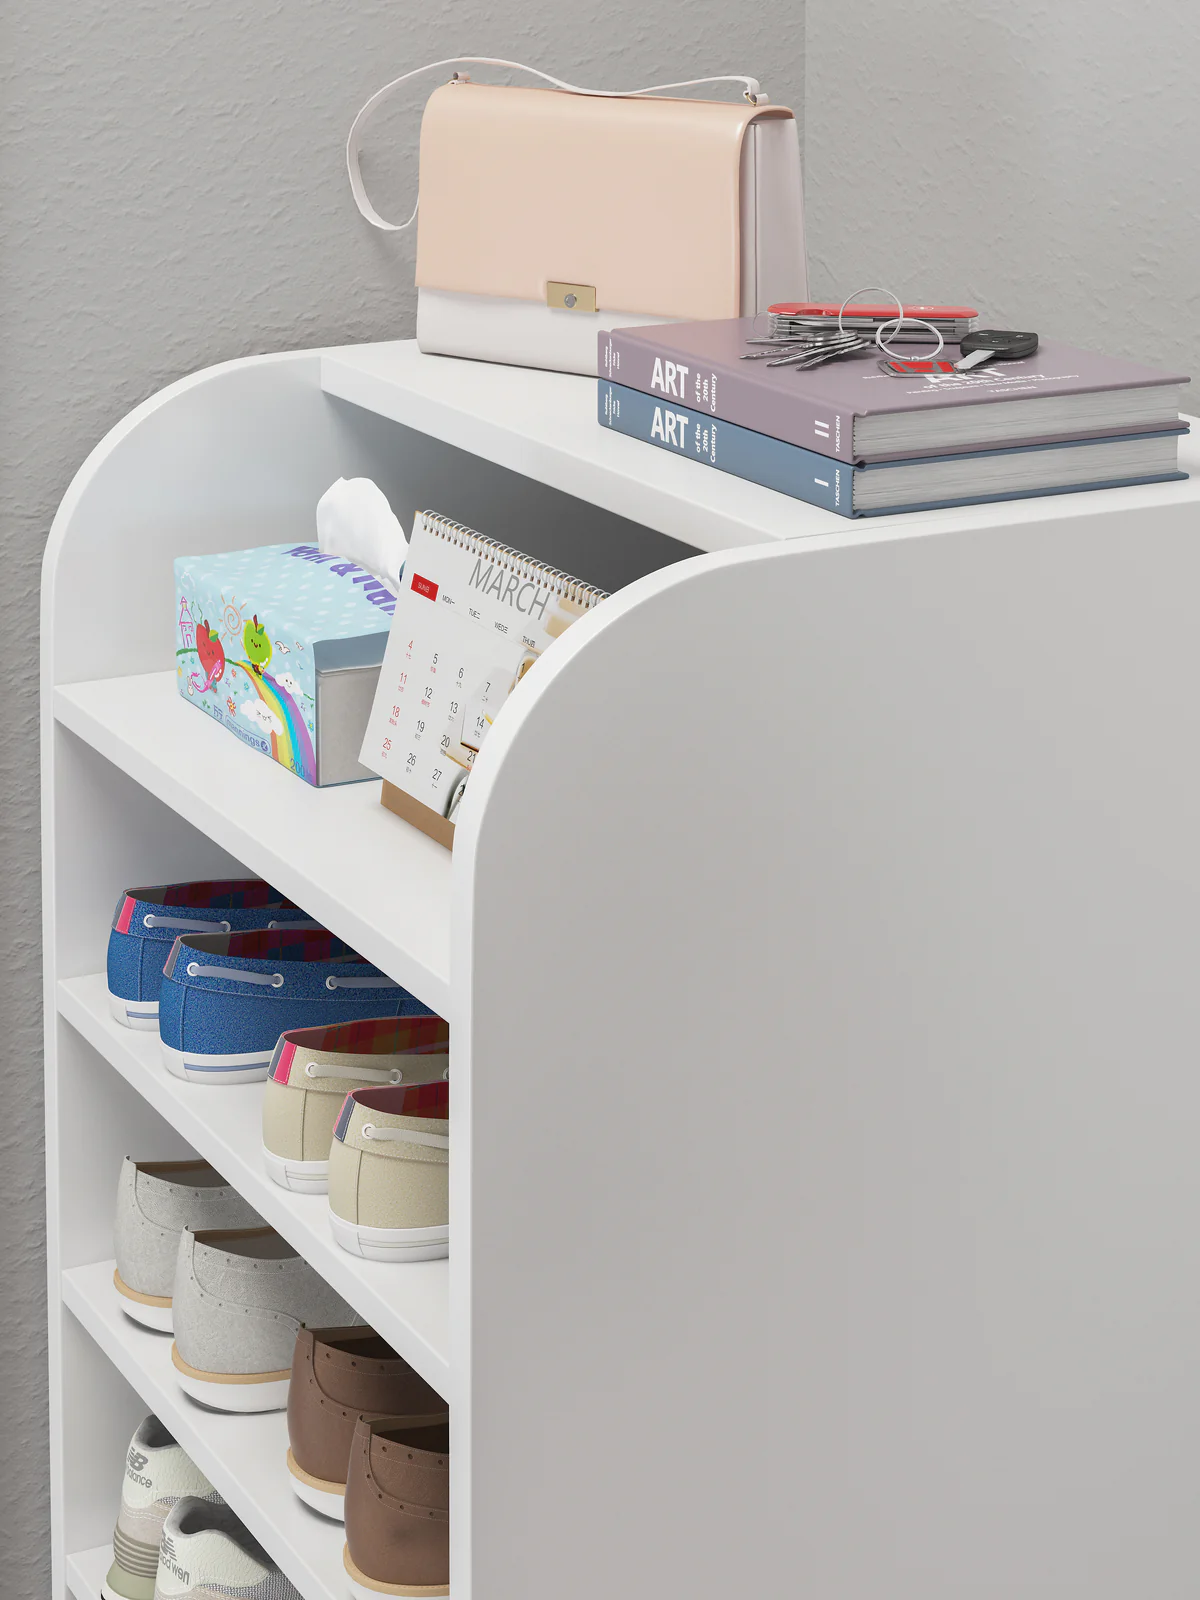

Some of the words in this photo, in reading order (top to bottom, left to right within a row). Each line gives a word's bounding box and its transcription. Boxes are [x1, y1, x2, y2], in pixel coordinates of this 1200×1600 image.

[650, 357, 688, 399] ART
[695, 390, 701, 403] of
[650, 406, 688, 449] ART
[695, 440, 701, 453] of
[468, 558, 551, 620] MARCH
[408, 640, 413, 650] 4
[432, 653, 438, 664] 5
[458, 667, 464, 679] 6
[485, 682, 491, 692] 7
[521, 662, 526, 673] 1
[400, 672, 408, 684] 11
[425, 686, 433, 700] 12
[450, 701, 458, 714] 13
[476, 716, 485, 729] 14
[392, 705, 400, 718] 18
[416, 720, 425, 733] 19
[440, 734, 451, 748] 20
[466, 750, 476, 764] 21
[382, 737, 392, 750] 25
[406, 752, 417, 766] 26
[432, 768, 442, 781] 27
